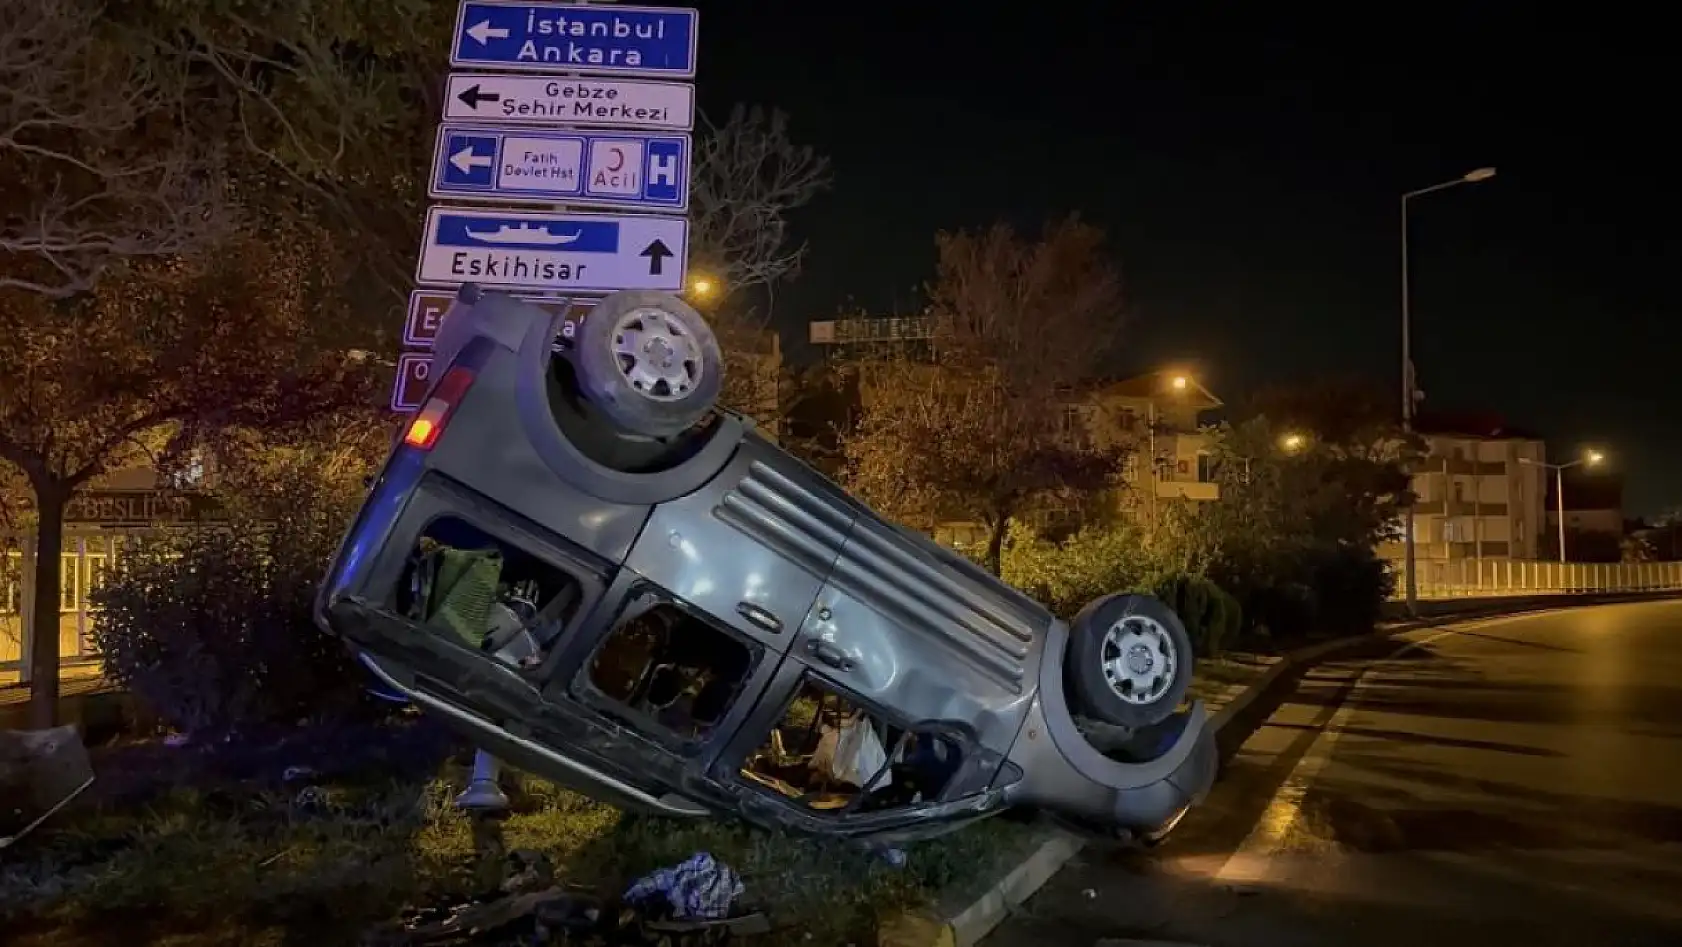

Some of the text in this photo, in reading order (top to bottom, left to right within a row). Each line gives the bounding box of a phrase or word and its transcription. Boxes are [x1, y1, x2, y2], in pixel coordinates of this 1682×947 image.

[526, 10, 665, 38] İstanbul
[518, 40, 642, 66] Ankara
[545, 82, 619, 100] Gebze
[502, 100, 668, 121] Şehir Merkezi
[524, 151, 558, 165] Fatih
[504, 163, 548, 178] Devlet
[594, 172, 636, 188] Acil
[649, 154, 676, 186] H
[451, 252, 587, 281] Eskihisar
